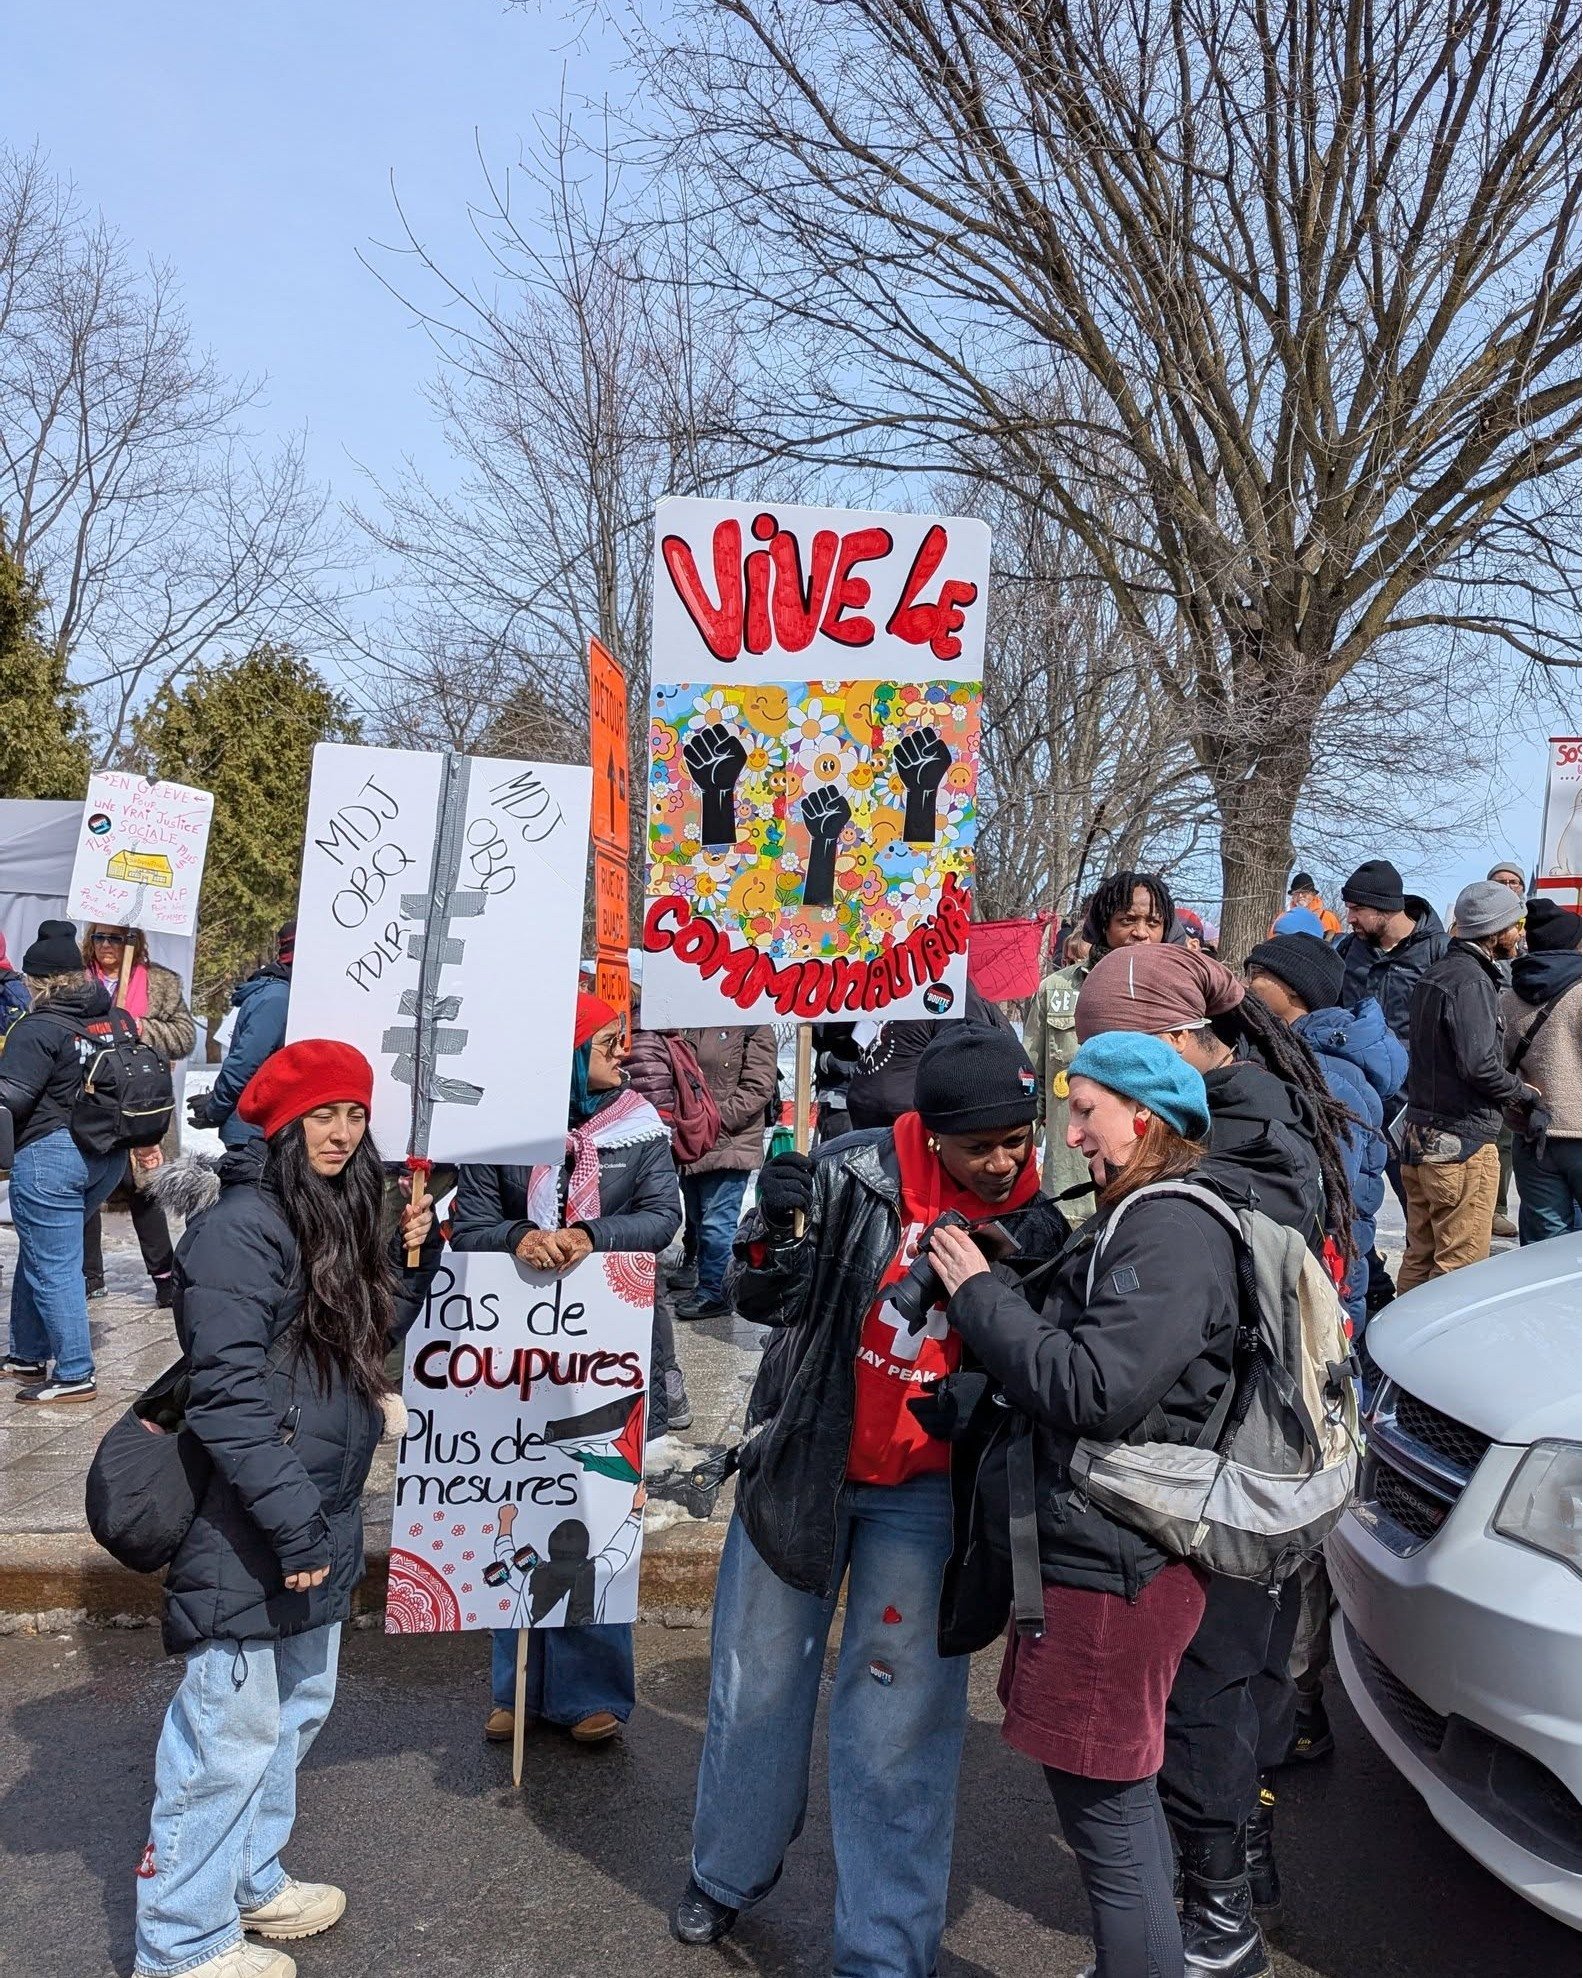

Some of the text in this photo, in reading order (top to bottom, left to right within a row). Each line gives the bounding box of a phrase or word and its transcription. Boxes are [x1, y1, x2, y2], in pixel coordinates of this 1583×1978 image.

[885, 524, 979, 661] LE
[109, 775, 130, 790] EN
[489, 770, 567, 843] MDJ
[314, 774, 399, 865] MDJ
[332, 843, 416, 929] OBQ
[601, 867, 625, 902] RUE DE
[346, 921, 412, 992] PDLR
[601, 972, 616, 1000] RUE
[424, 1265, 588, 1336] Pas de
[887, 1364, 938, 1383] PEAK
[399, 1408, 547, 1465] Plus de
[396, 1472, 579, 1507] mesures
[1394, 1485, 1437, 1521] DODGE
